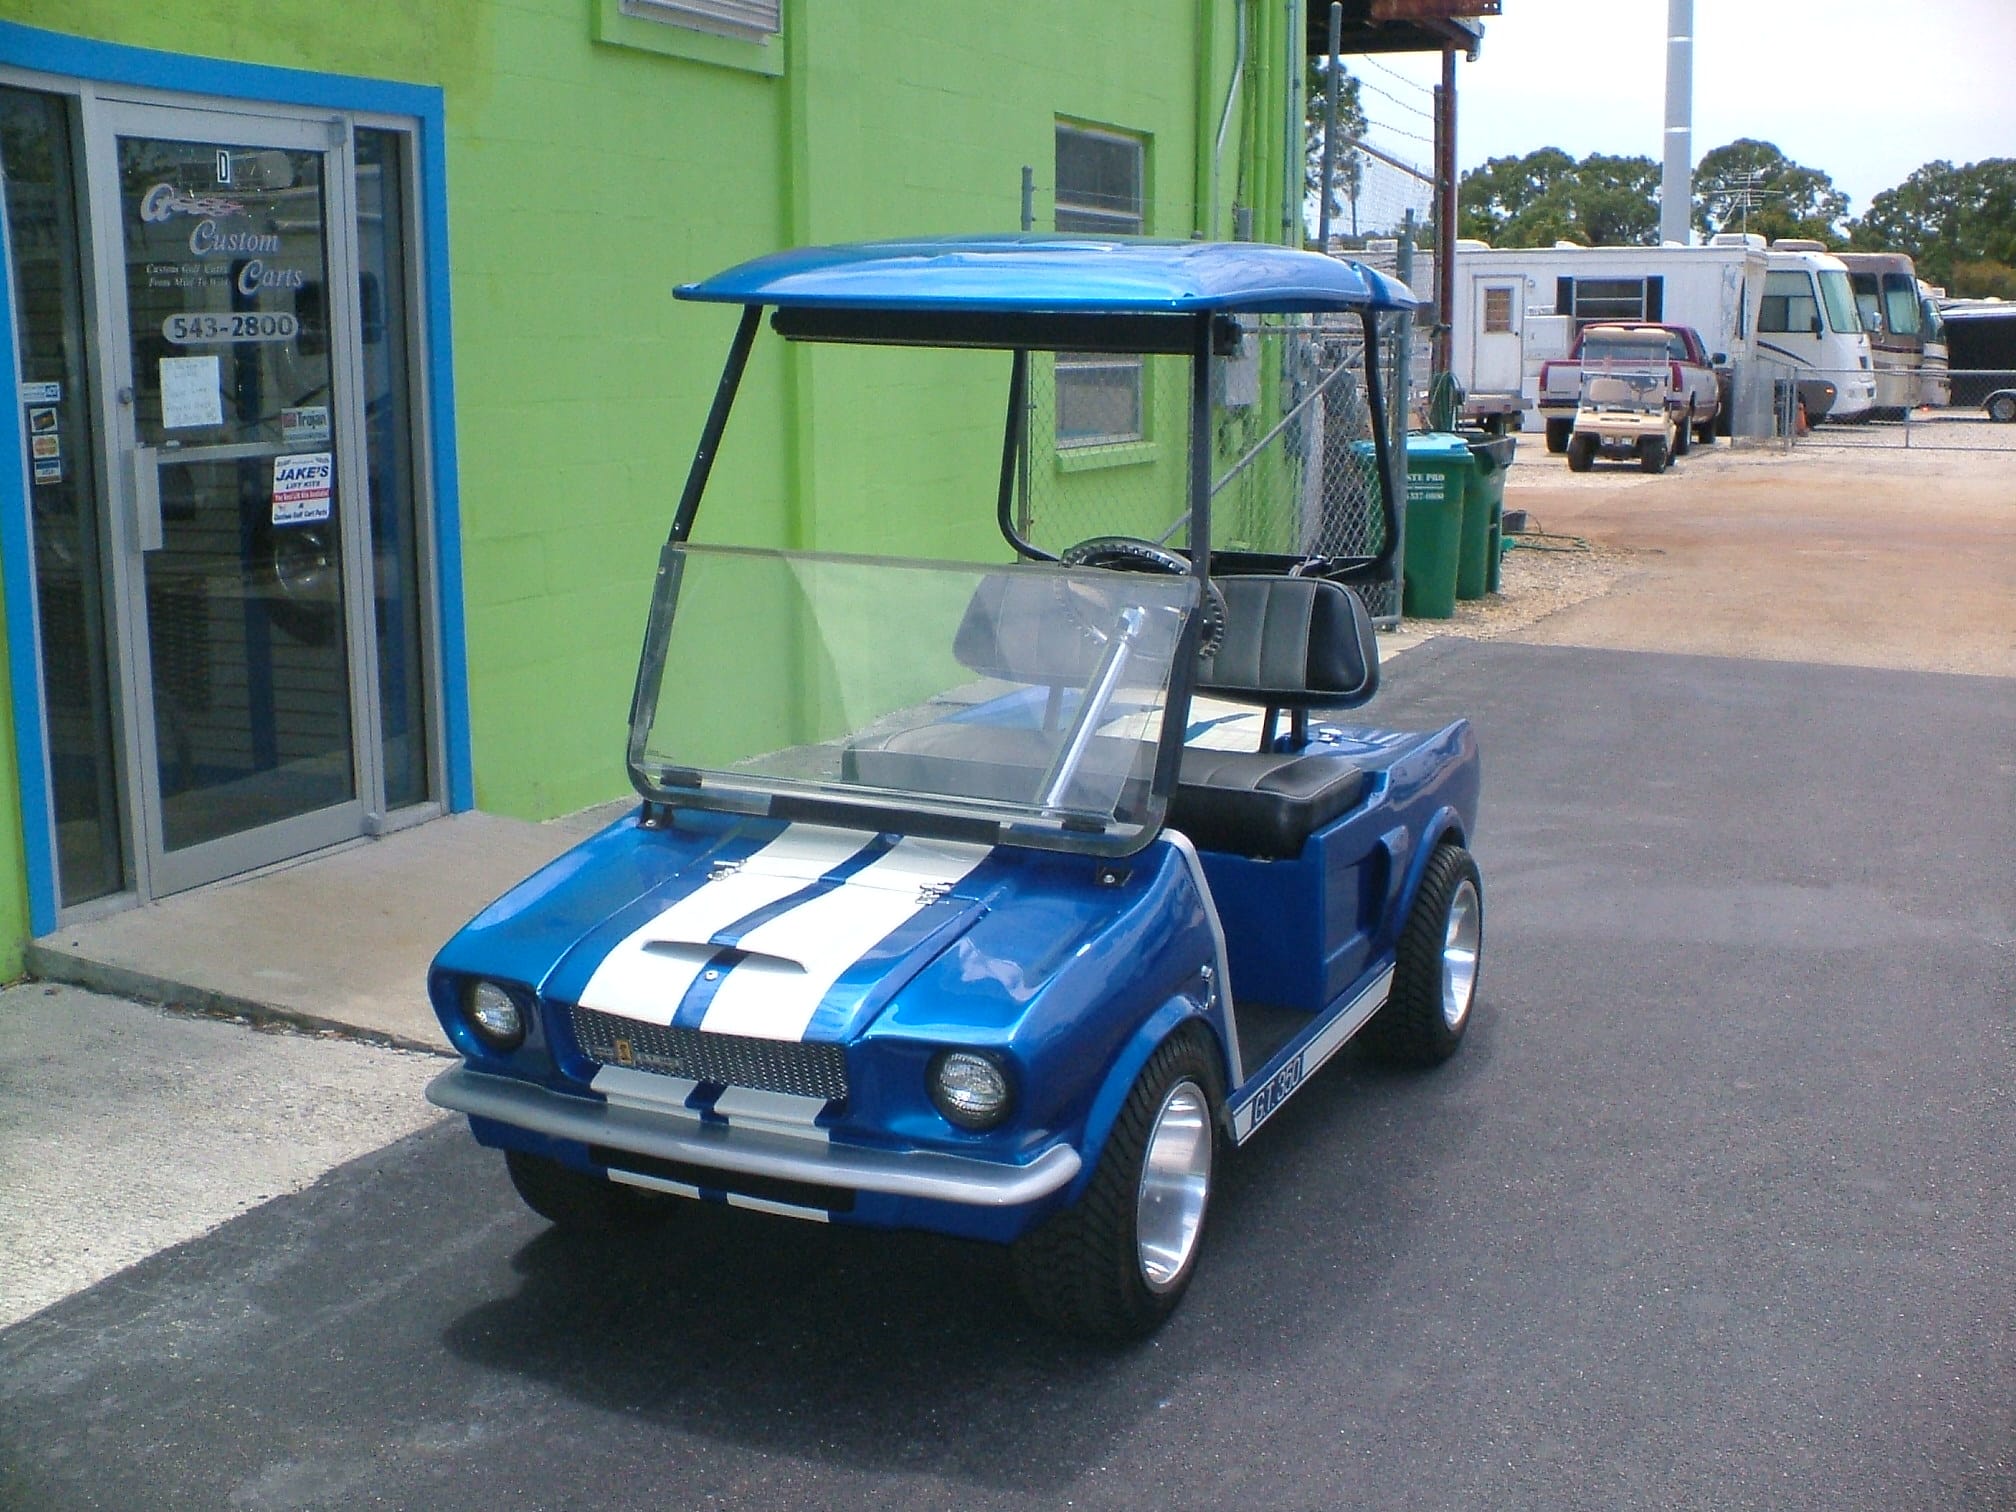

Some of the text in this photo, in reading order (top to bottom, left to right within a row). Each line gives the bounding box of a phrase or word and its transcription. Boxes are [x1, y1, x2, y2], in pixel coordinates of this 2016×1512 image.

[217, 150, 230, 183] D
[190, 219, 279, 255] Custom
[238, 259, 303, 296] Carts
[174, 314, 294, 339] 543-2800
[297, 411, 327, 430] Trojan
[276, 465, 329, 481] JAKE'S
[1406, 473, 1424, 481] STE
